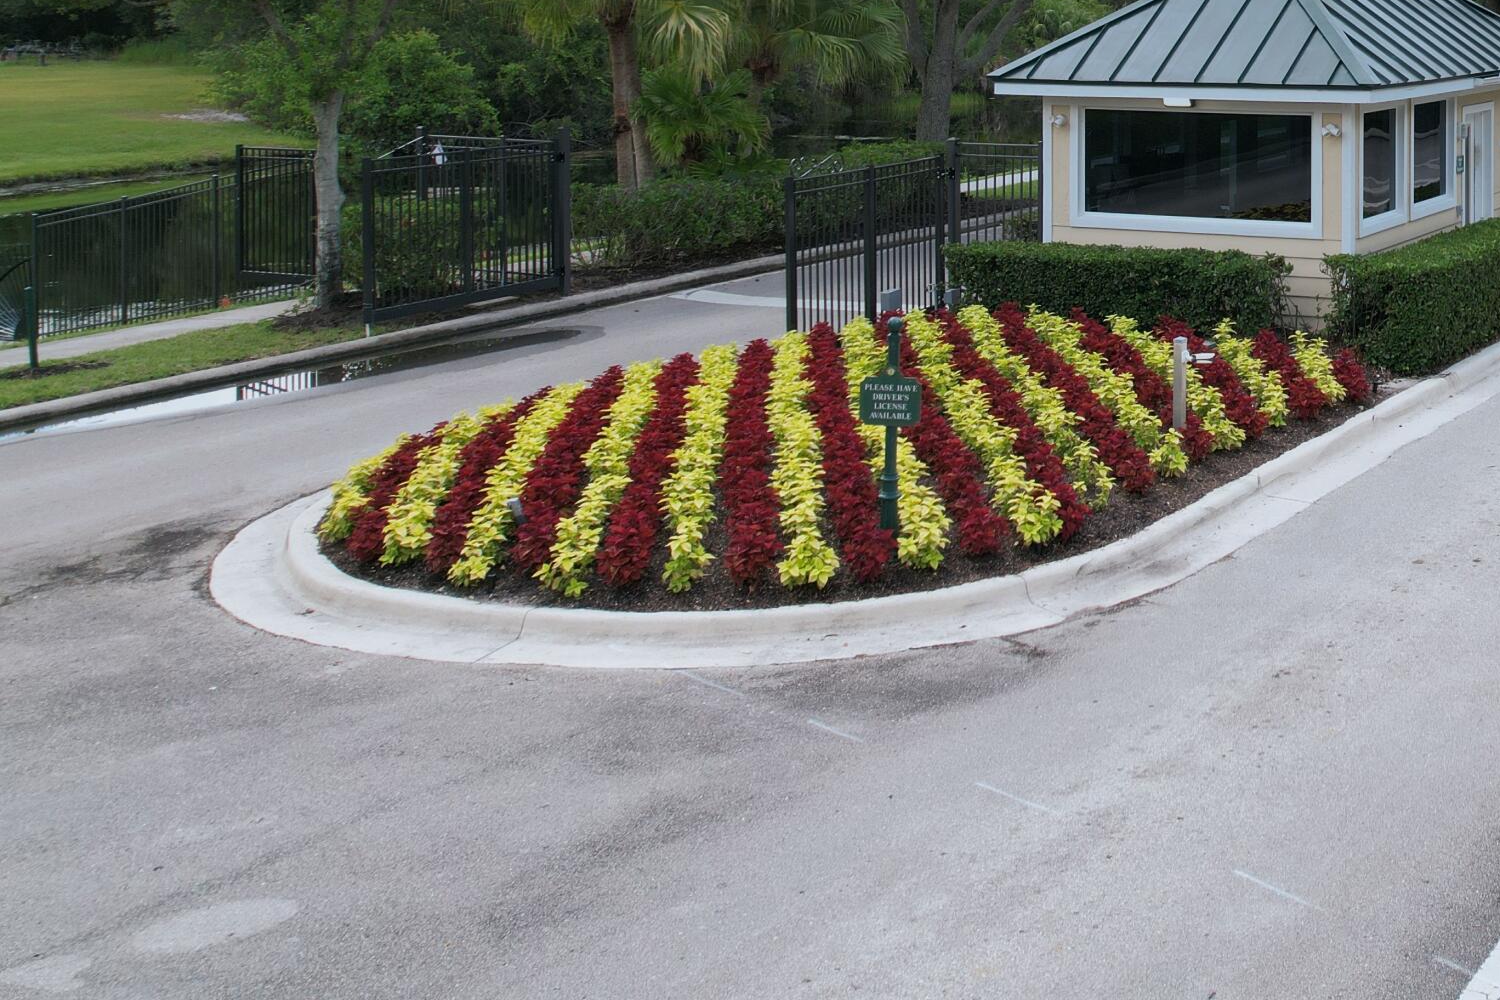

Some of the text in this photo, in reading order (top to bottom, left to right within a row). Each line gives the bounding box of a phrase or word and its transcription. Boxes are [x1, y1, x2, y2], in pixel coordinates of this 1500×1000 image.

[864, 383, 894, 391] PLEASE
[873, 393, 910, 401] DRIVER'S
[874, 403, 908, 411] LICENSE
[869, 412, 912, 420] AVAILABLE
